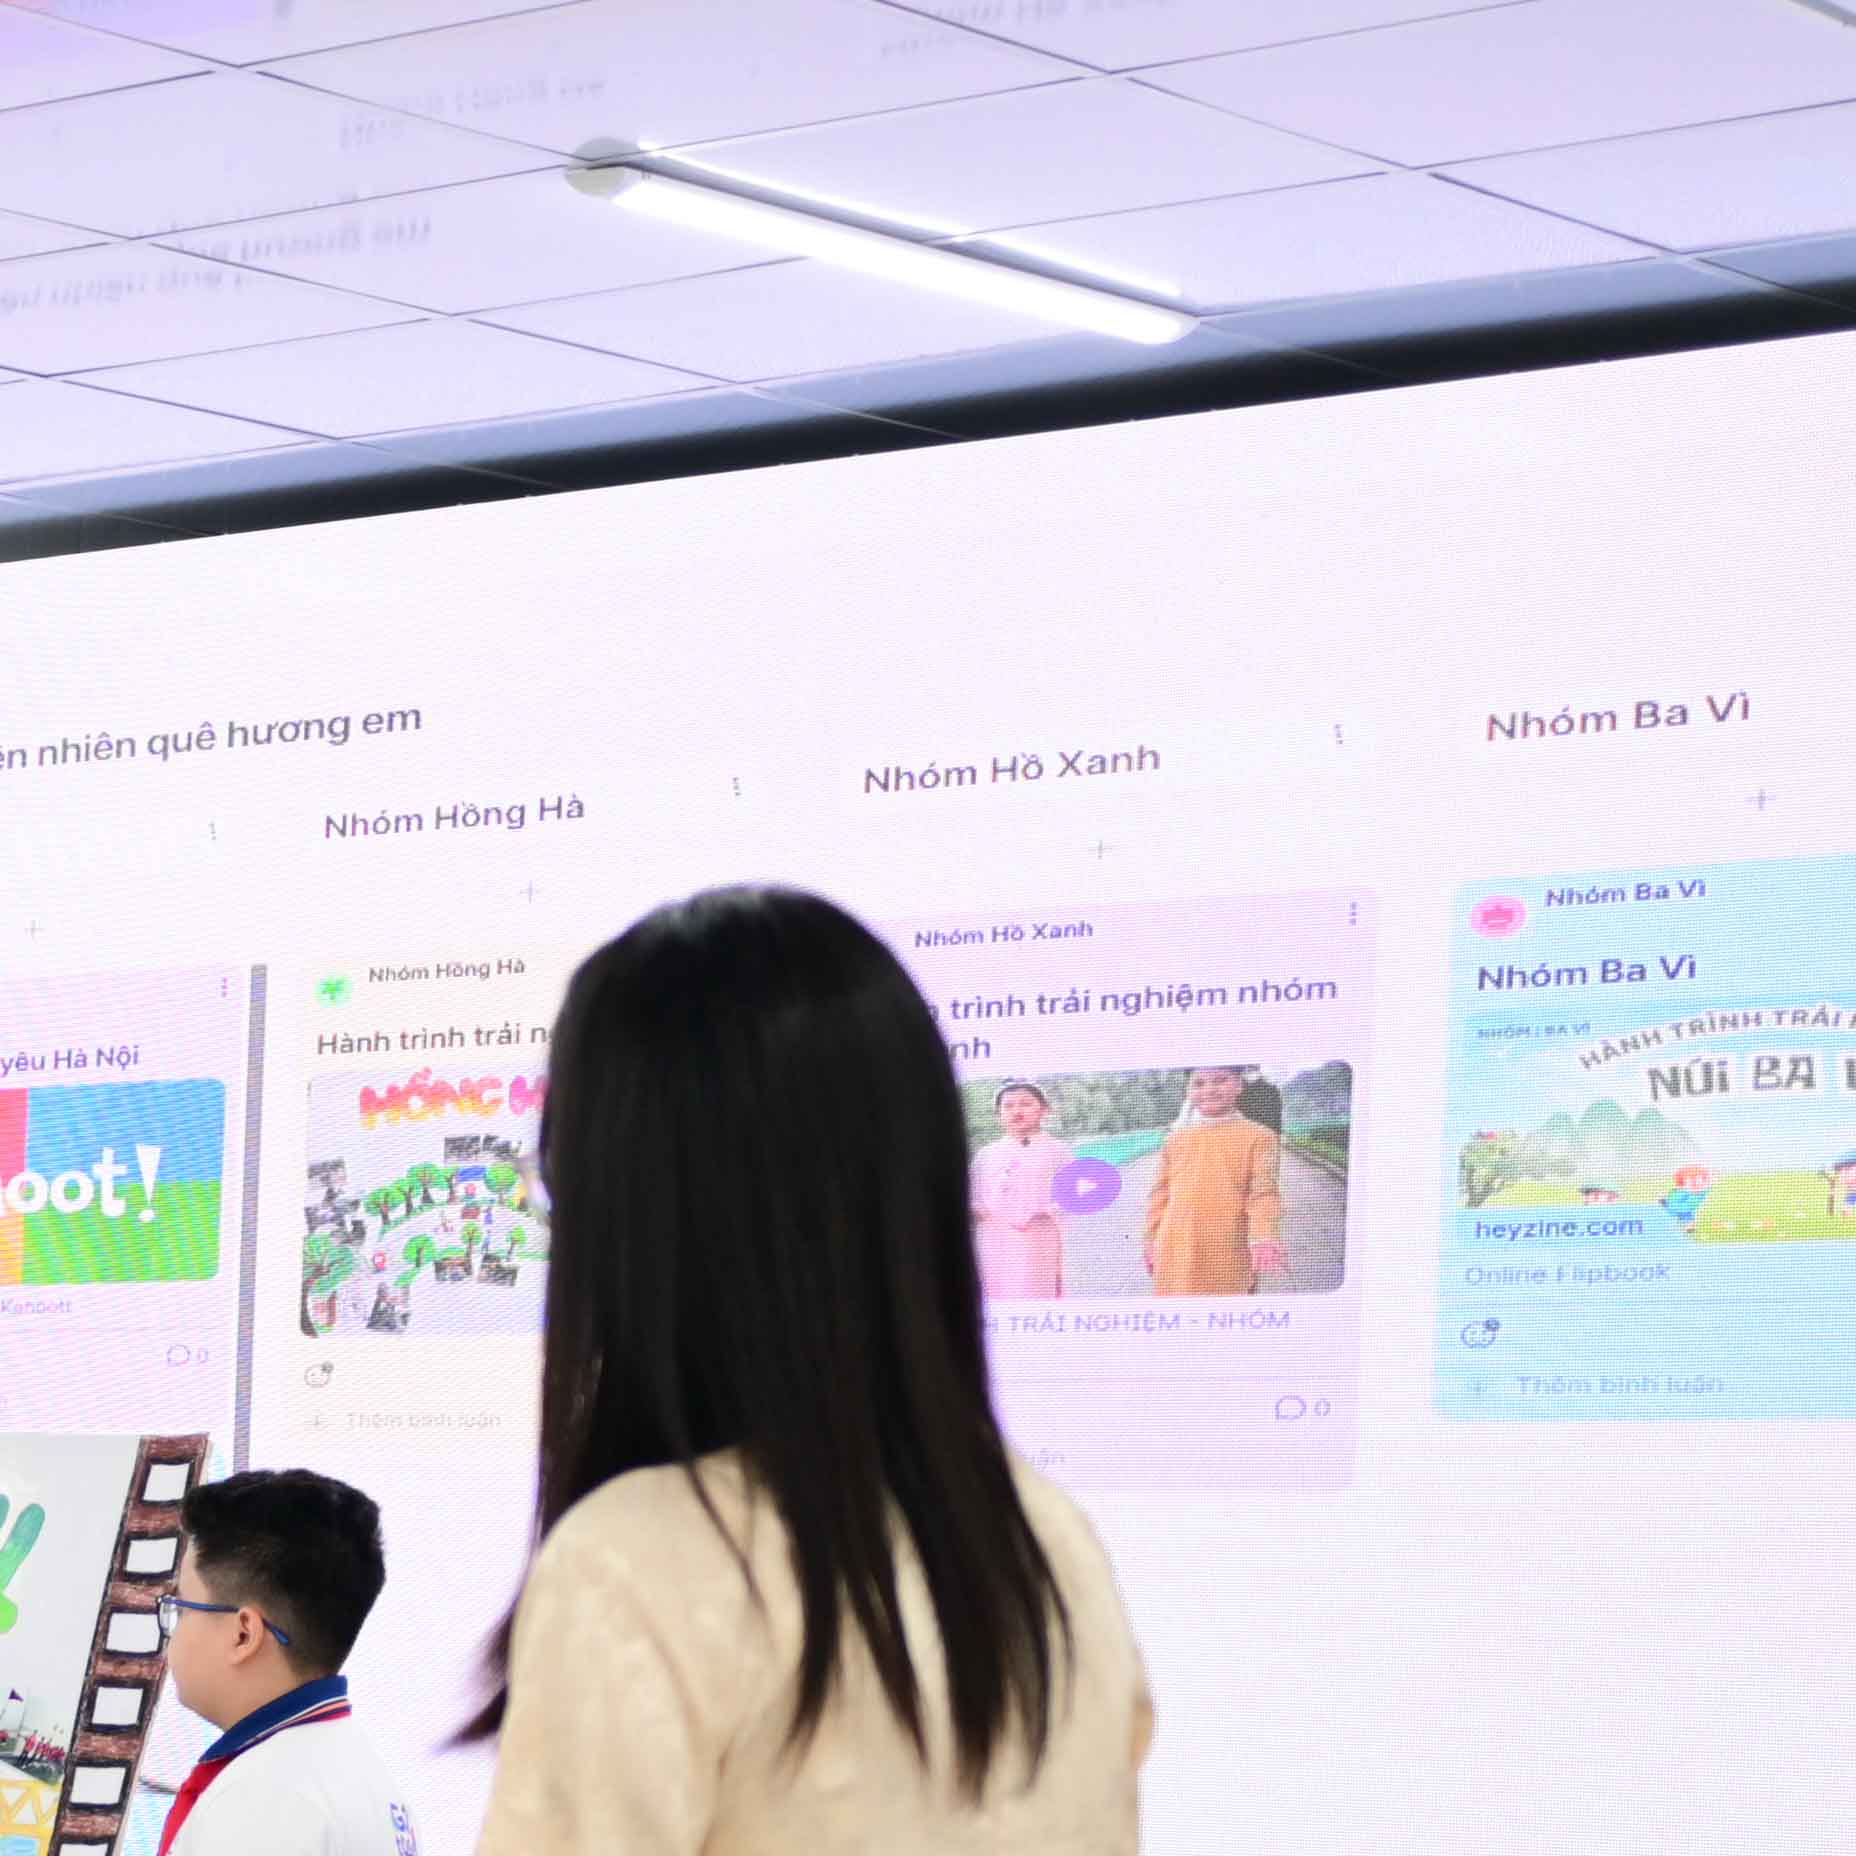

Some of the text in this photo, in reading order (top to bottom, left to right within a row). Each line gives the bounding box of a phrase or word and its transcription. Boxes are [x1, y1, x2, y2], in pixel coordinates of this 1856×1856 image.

[1487, 688, 1750, 741] Nhóm Ba Vì
[38, 732, 137, 766] nhiên
[147, 721, 216, 761] quê
[227, 715, 351, 748] hương
[362, 707, 422, 734] em
[864, 744, 1161, 794] Nhóm Hồ Xanh
[325, 794, 584, 838] Nhóm Hồng Hà
[1545, 886, 1625, 907] Nhóm
[1635, 882, 1669, 903] Ba
[915, 929, 984, 948] Nhóm
[1032, 921, 1094, 939] Xanh
[369, 965, 429, 982] Nhóm
[1477, 962, 1588, 991] Nhóm
[1601, 958, 1647, 984] Ba
[1037, 988, 1090, 1016] trải
[1100, 984, 1227, 1015] nghiệm
[1238, 978, 1337, 1003] nhóm
[317, 1032, 389, 1055] Hành
[400, 1027, 464, 1050] trình
[475, 1021, 520, 1045] trải
[0, 1051, 46, 1078] yêu
[53, 1049, 88, 1070] Hà
[96, 1045, 139, 1071] Nội
[1752, 1054, 1817, 1091] BA
[1476, 1218, 1644, 1242] heyzine.com
[1465, 1265, 1671, 1286] Online Flipbook
